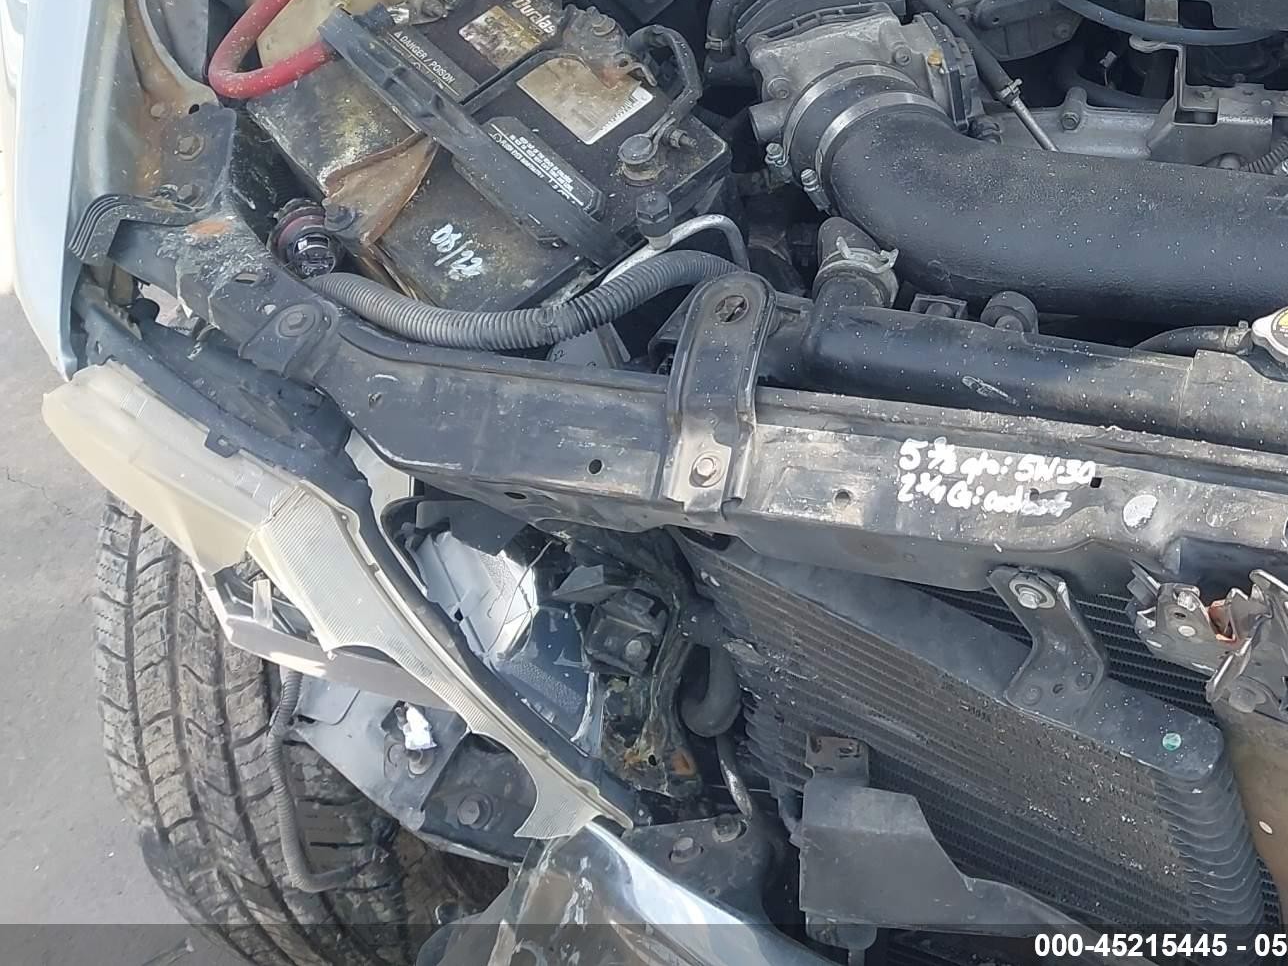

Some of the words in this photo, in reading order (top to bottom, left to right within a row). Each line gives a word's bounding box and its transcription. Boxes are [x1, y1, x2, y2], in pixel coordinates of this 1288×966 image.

[400, 35, 428, 60] DANGER
[428, 60, 456, 84] POISON
[899, 438, 928, 470] 5
[898, 473, 916, 502] 2
